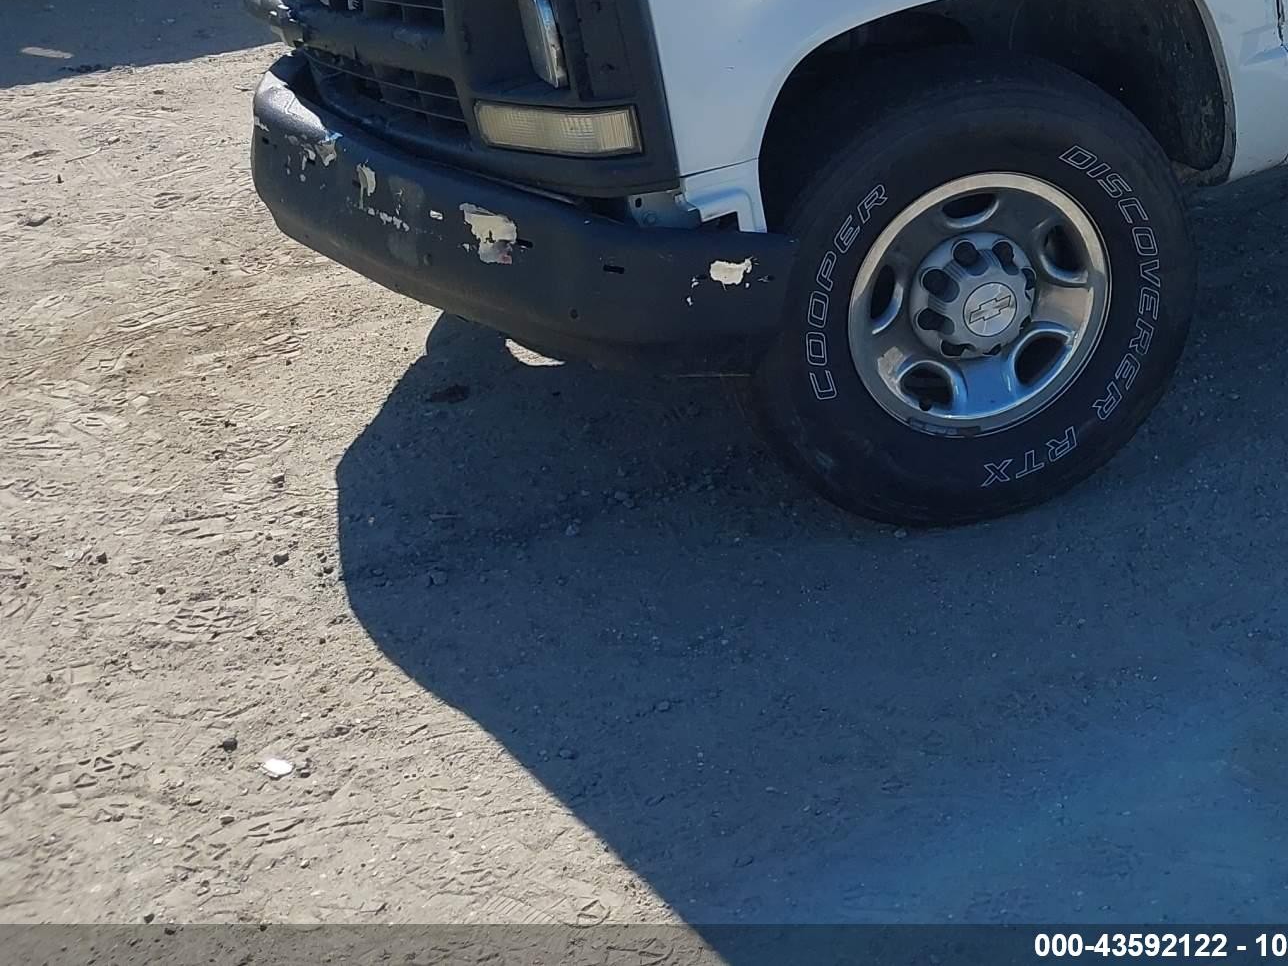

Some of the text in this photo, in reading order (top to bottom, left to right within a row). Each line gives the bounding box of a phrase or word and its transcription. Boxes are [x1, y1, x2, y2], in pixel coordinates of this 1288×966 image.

[805, 183, 889, 400] COOPER
[1058, 144, 1162, 421] DISCOVERER
[981, 426, 1079, 487] RTX
